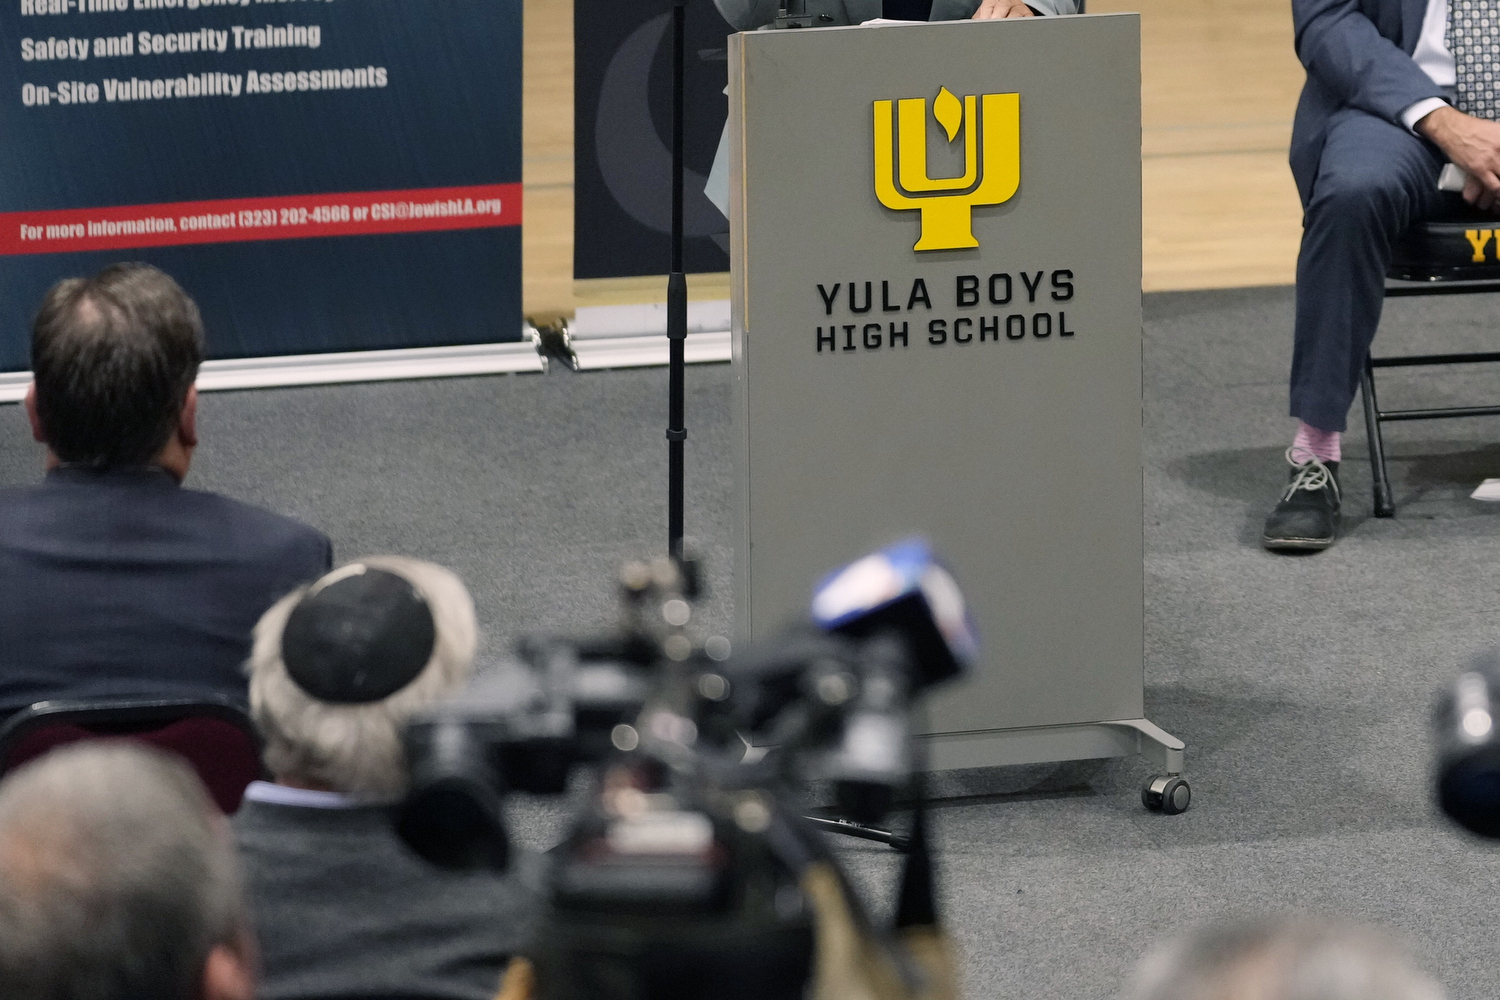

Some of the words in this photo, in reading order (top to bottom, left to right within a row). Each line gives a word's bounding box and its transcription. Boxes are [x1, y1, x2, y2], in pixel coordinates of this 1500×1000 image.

[21, 36, 90, 63] Safety
[94, 33, 134, 57] and
[138, 26, 228, 55] Security
[232, 23, 322, 50] Training
[22, 82, 100, 106] On-Site
[103, 71, 243, 102] Vulnerability
[246, 65, 388, 93] Assessments
[20, 223, 44, 241] For
[48, 219, 85, 240] more
[88, 215, 178, 238] information,
[180, 210, 236, 230] contact
[239, 208, 278, 228] (323)
[353, 205, 368, 221] or
[817, 278, 933, 315] YULA
[956, 269, 1075, 308] BOYS
[816, 321, 910, 352] HIGH
[928, 311, 1076, 345] SCHOOL
